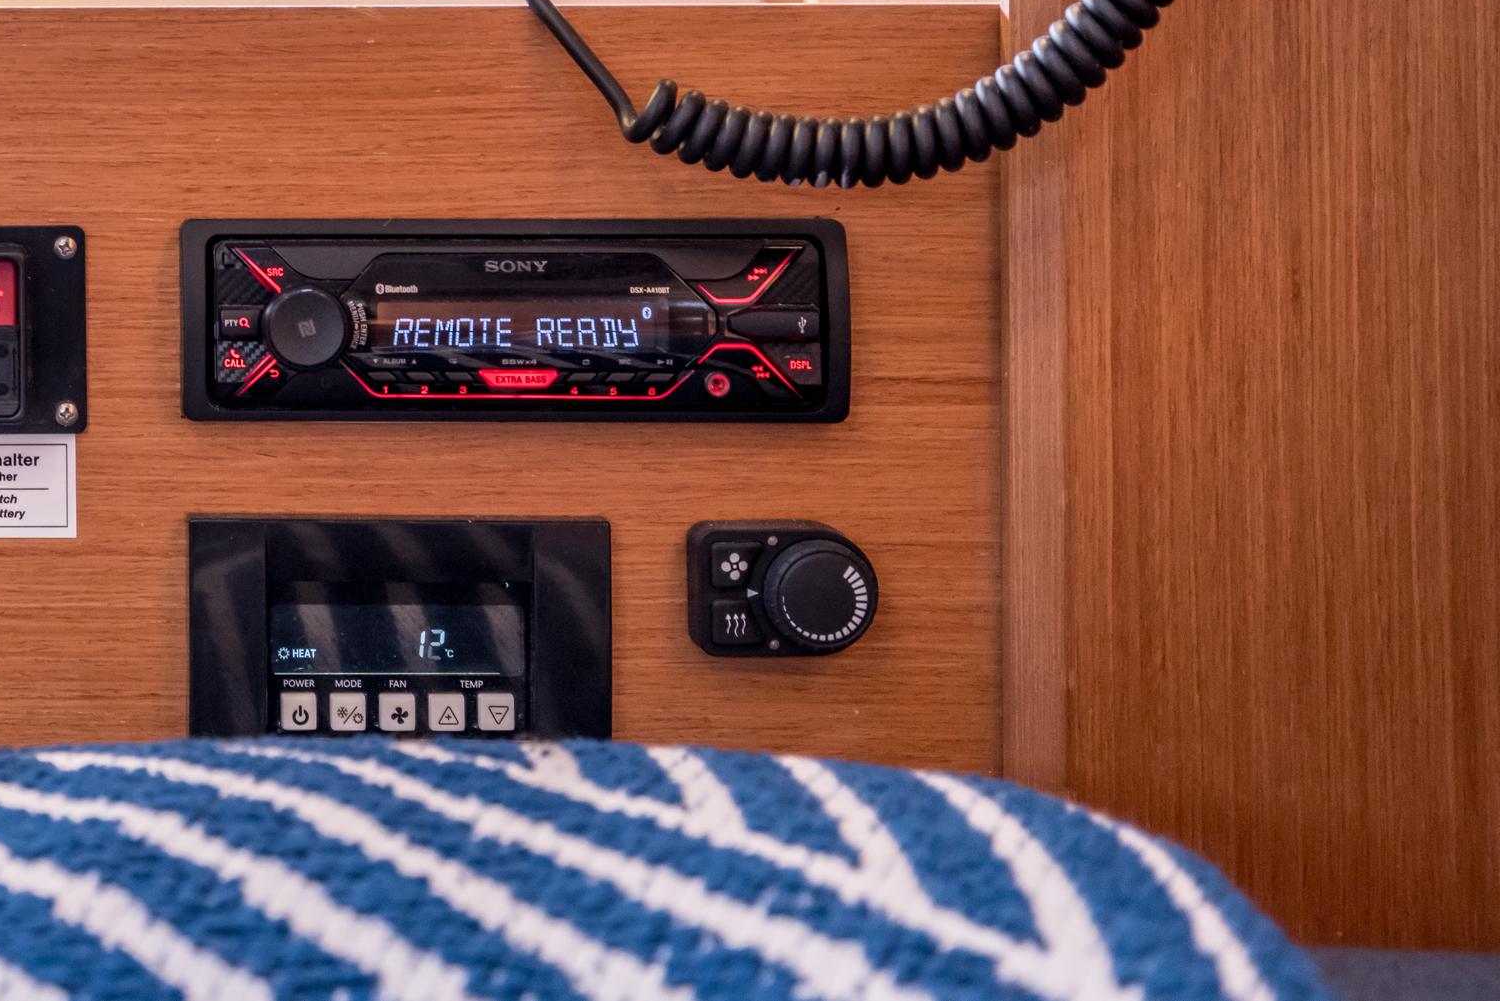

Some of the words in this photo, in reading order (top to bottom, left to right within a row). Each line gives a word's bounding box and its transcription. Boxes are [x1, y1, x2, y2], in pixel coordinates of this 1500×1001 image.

[484, 260, 548, 273] SONY
[267, 267, 284, 277] SRC
[385, 284, 418, 293] Bluetooth
[224, 320, 238, 328] PTY
[393, 318, 512, 347] REMOTE
[536, 318, 639, 347] READY
[224, 358, 246, 368] CALL
[789, 360, 812, 370] DSPL
[495, 375, 522, 384] EXTRA
[525, 375, 547, 384] BASS
[382, 385, 389, 394] 1
[420, 385, 428, 394] 2
[459, 385, 467, 394] 3
[570, 386, 578, 395] 4
[609, 387, 617, 395] 5
[648, 387, 656, 396] 6
[292, 648, 317, 659] HEAT
[283, 679, 315, 688] POWER
[335, 679, 362, 688] MODE
[388, 679, 407, 688] FAN
[460, 680, 484, 689] TEMP
